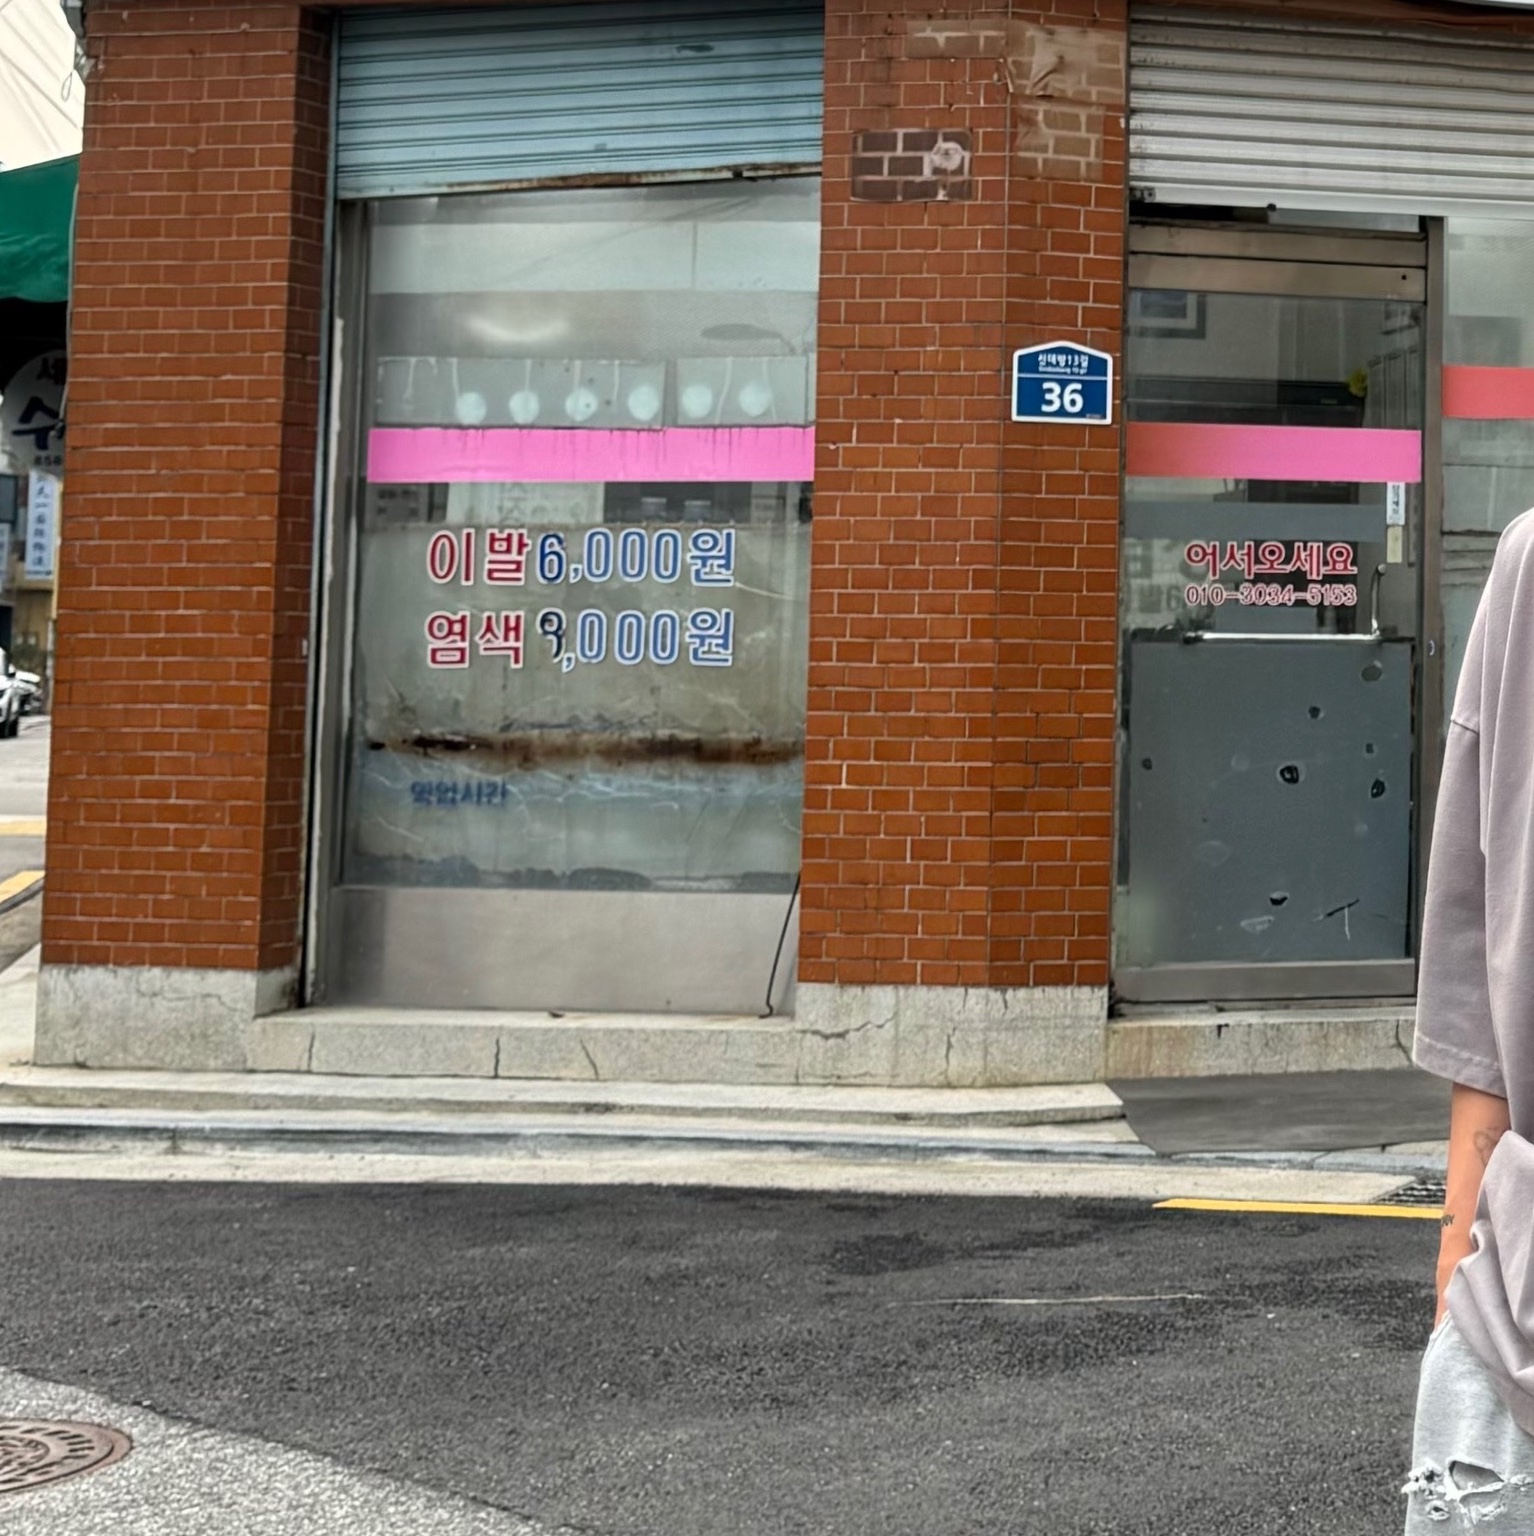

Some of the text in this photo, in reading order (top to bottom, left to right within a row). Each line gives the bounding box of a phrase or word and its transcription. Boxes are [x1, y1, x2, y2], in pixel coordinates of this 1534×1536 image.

[1041, 381, 1084, 413] 36
[427, 527, 736, 587] 이발 6,000원
[1184, 540, 1358, 581] 어서오세요
[1184, 582, 1358, 607] 010-3034-5153
[425, 610, 524, 669] 염색
